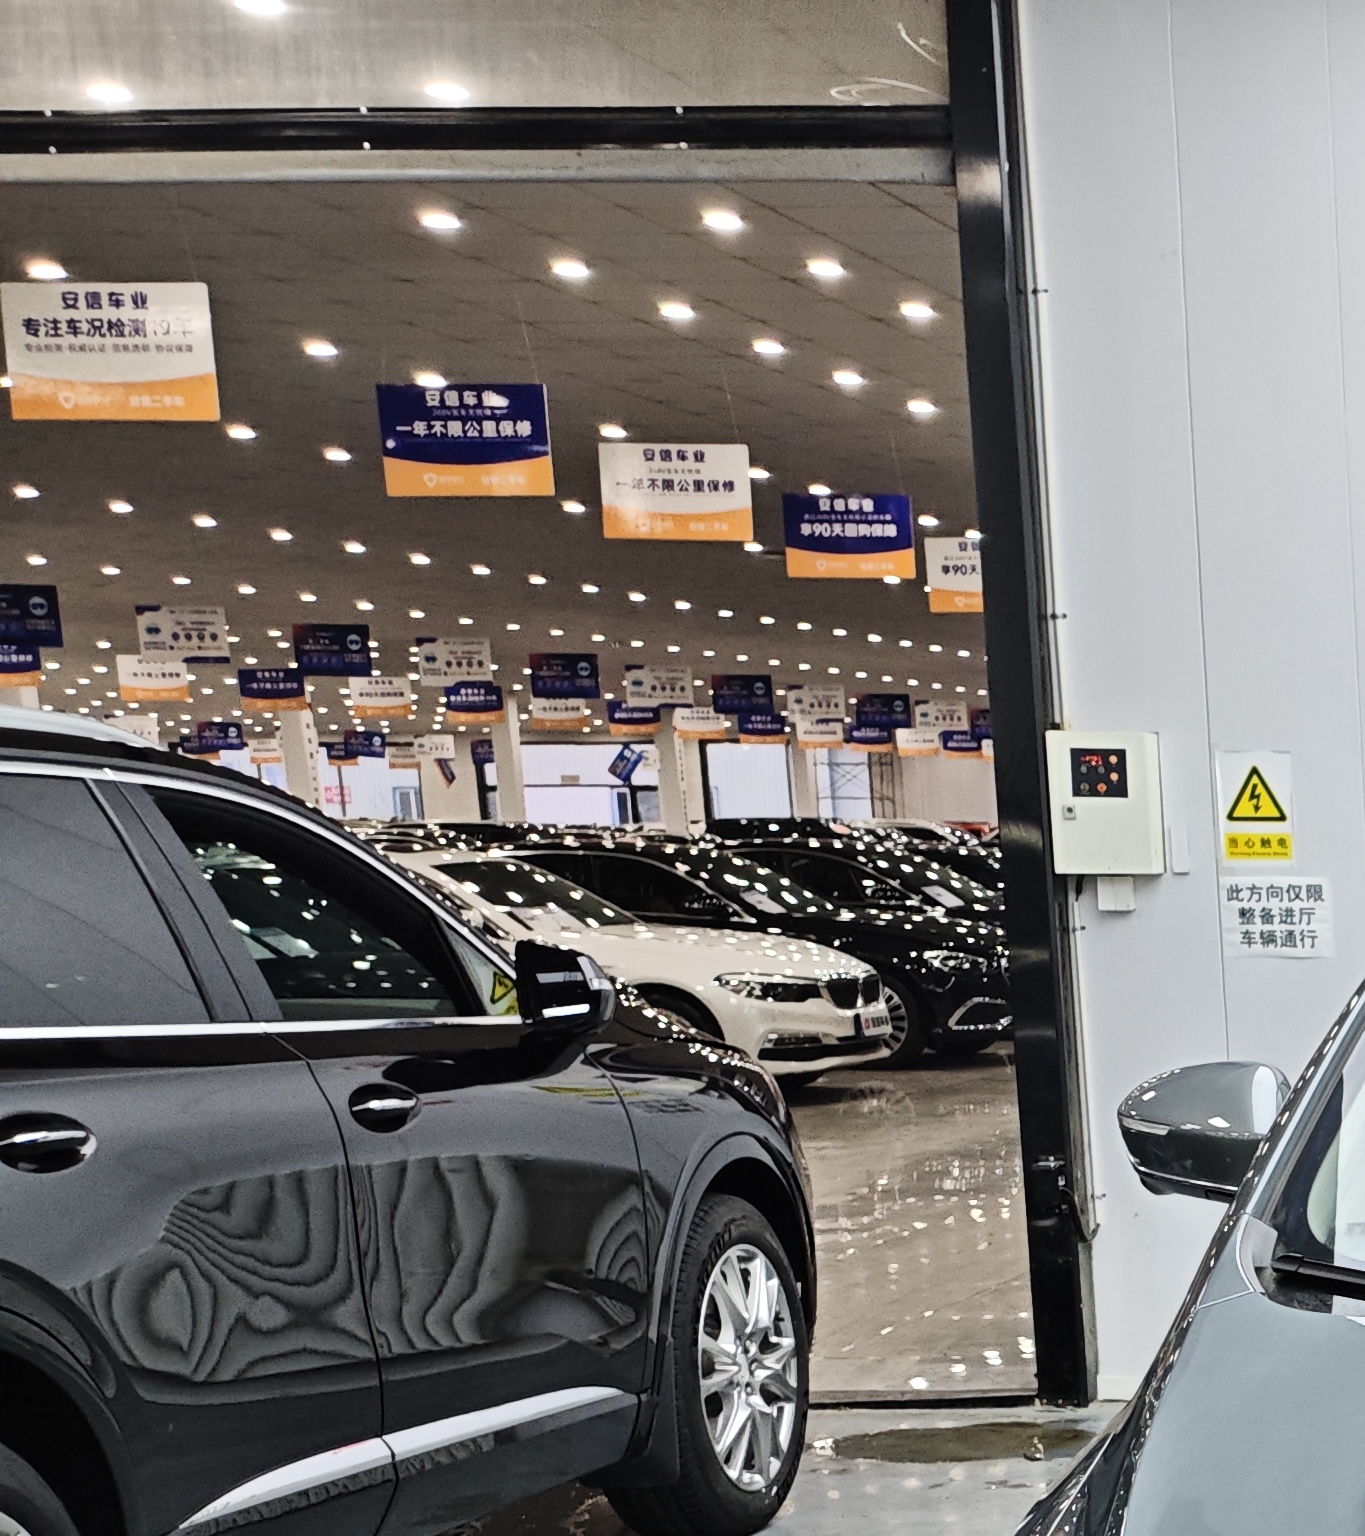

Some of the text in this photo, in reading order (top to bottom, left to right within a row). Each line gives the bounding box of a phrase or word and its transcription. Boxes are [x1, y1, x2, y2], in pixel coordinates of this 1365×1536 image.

[61, 291, 149, 310] 安信车业
[396, 420, 532, 438] 一年不限公里保修
[643, 448, 706, 463] 安信车业
[616, 477, 735, 493] 一年不限公里保修
[1228, 837, 1289, 849] 当心触电
[1226, 883, 1325, 903] 此方向仅限
[1238, 907, 1316, 926] 整备进厅
[1240, 929, 1319, 949] 车辆通行
